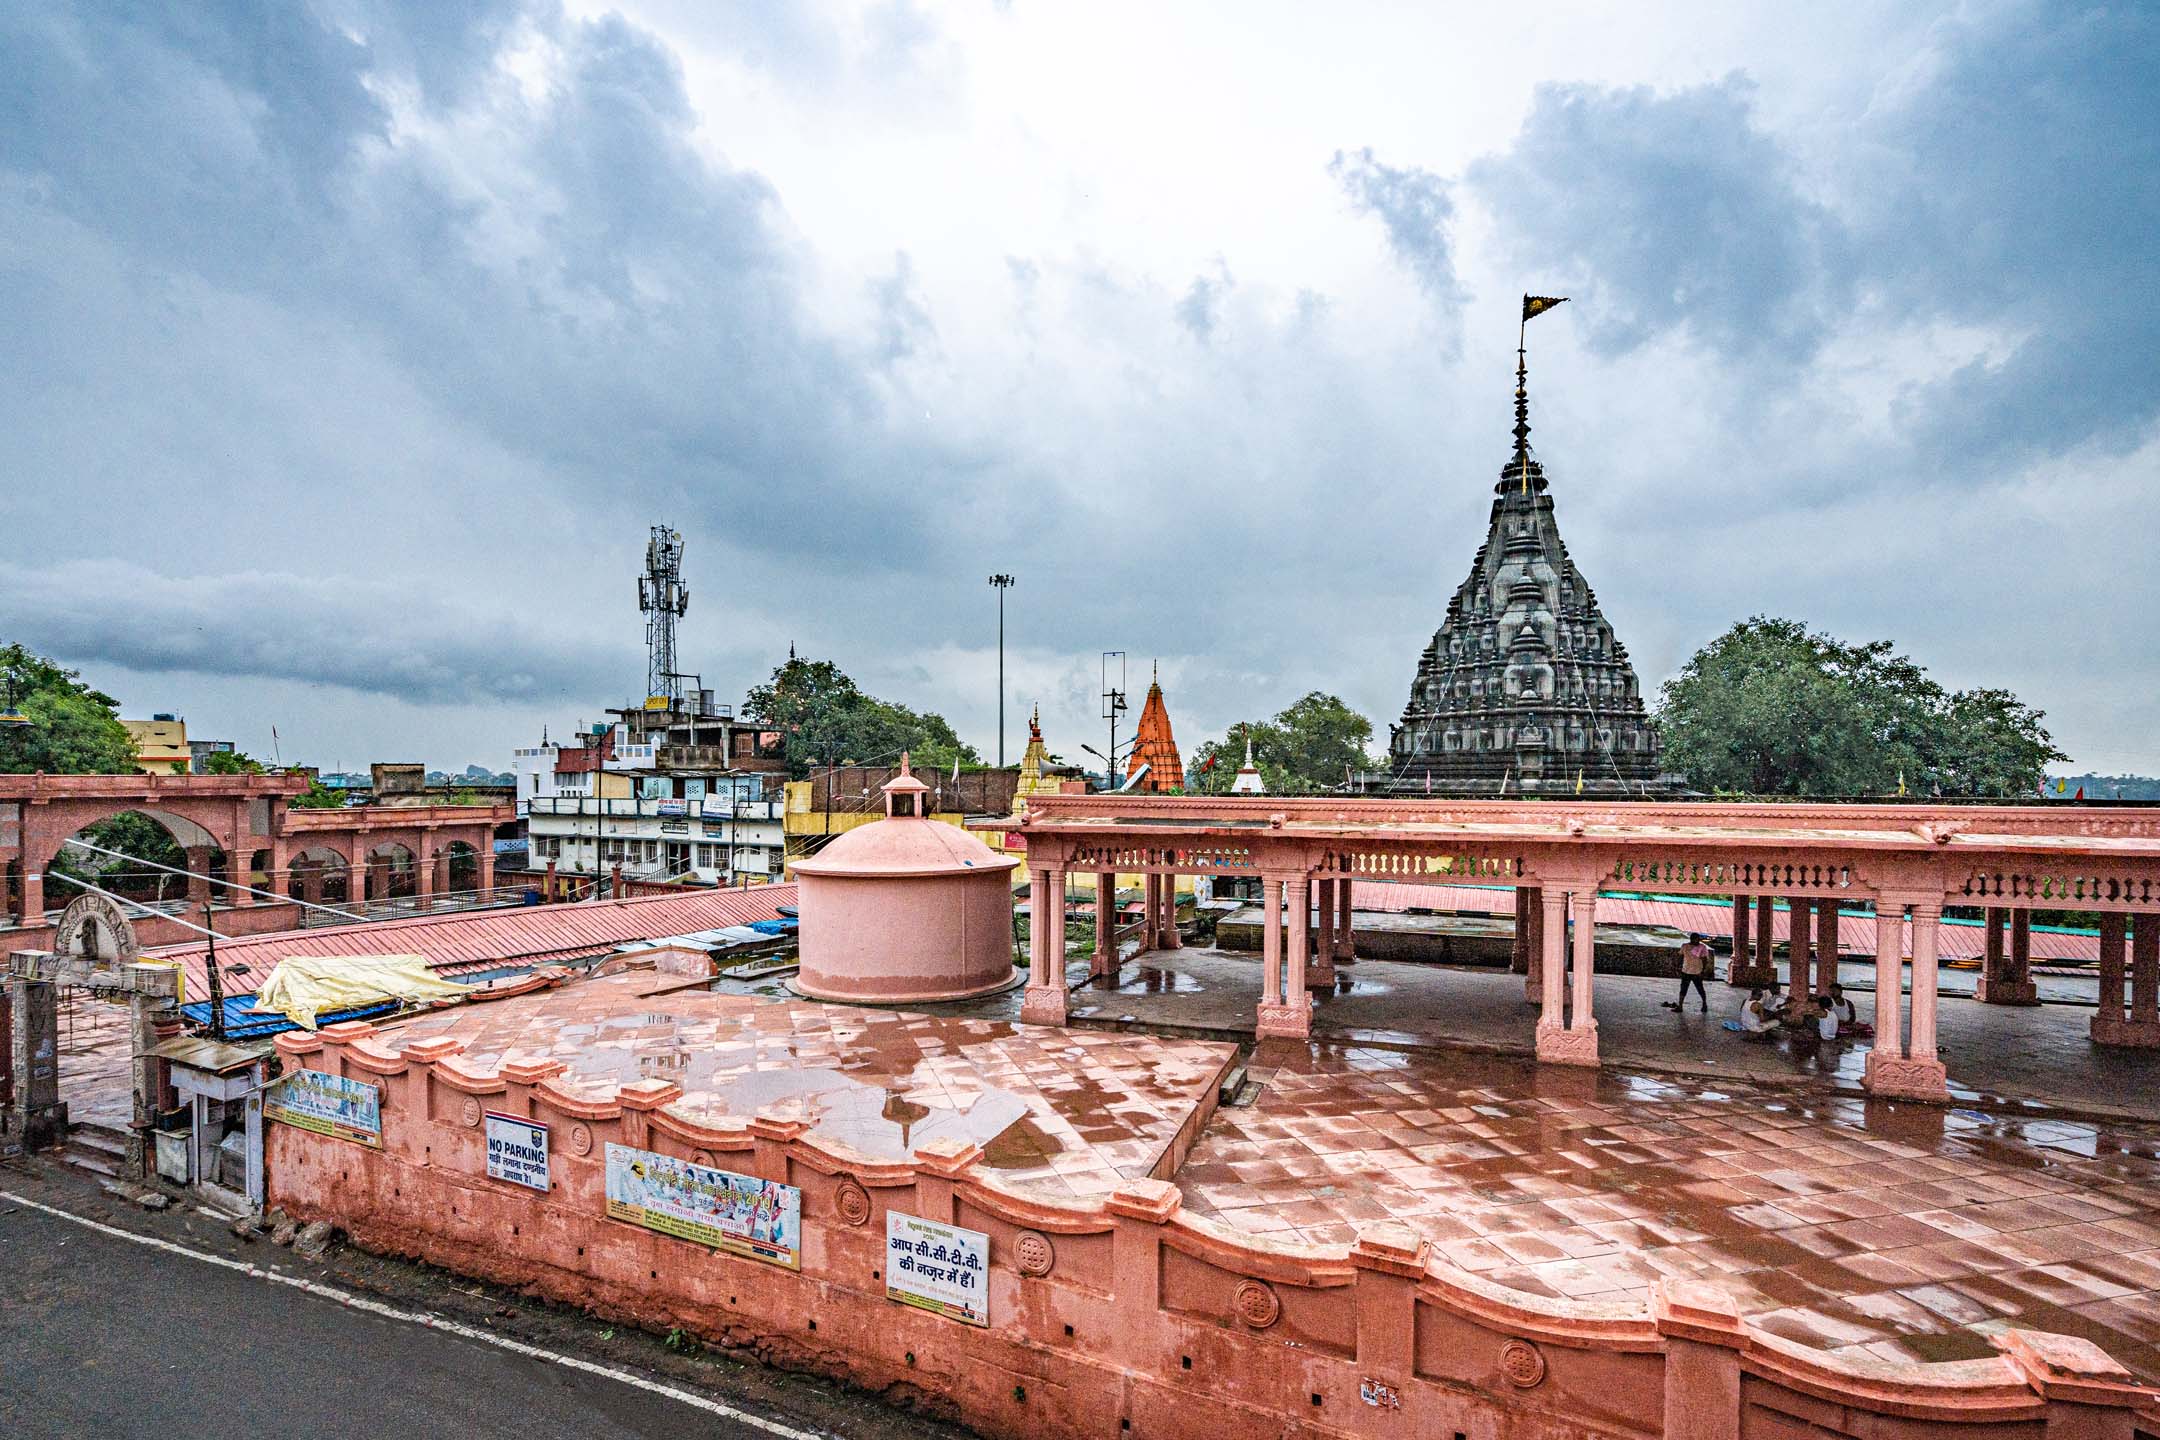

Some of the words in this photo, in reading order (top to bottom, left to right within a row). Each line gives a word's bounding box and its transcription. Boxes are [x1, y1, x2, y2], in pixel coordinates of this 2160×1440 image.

[489, 1138, 502, 1152] NO
[505, 1142, 545, 1163] PARKING
[745, 1191, 770, 1210] 2019
[891, 1237, 912, 1252] आप
[915, 1240, 983, 1271] सी.सी.टी.वी.
[899, 1255, 914, 1272] की
[917, 1262, 945, 1282] नज़र
[947, 1267, 958, 1283] में
